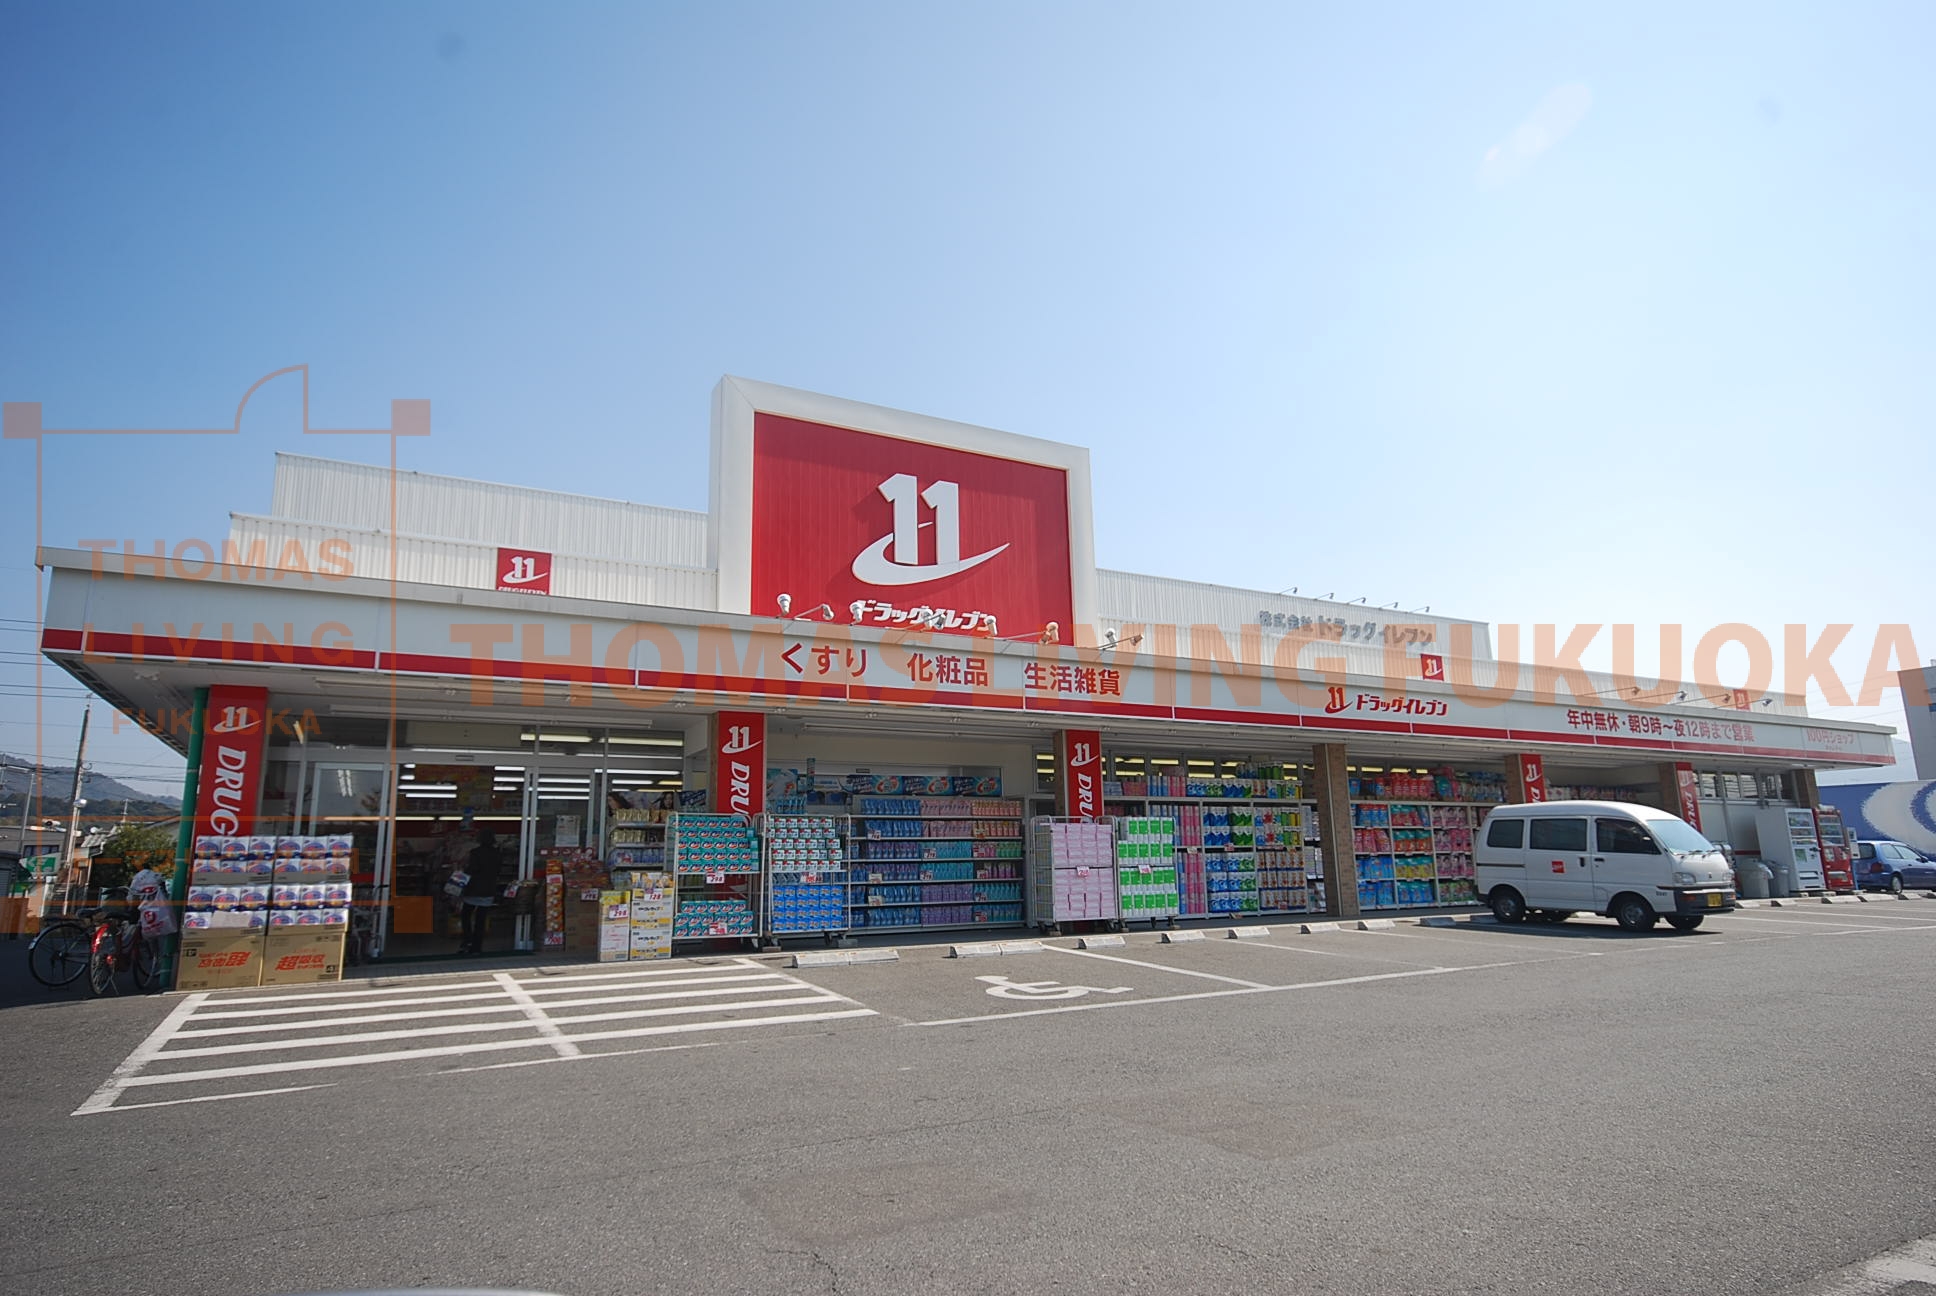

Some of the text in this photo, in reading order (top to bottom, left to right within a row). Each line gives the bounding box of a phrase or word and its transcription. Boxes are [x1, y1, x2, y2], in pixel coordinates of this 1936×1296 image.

[781, 643, 1121, 697] くすり 化粧品 生活雑貨
[1356, 694, 1448, 716] ドラッグイレブン
[210, 745, 247, 836] DRUG
[1078, 772, 1093, 818] DRU
